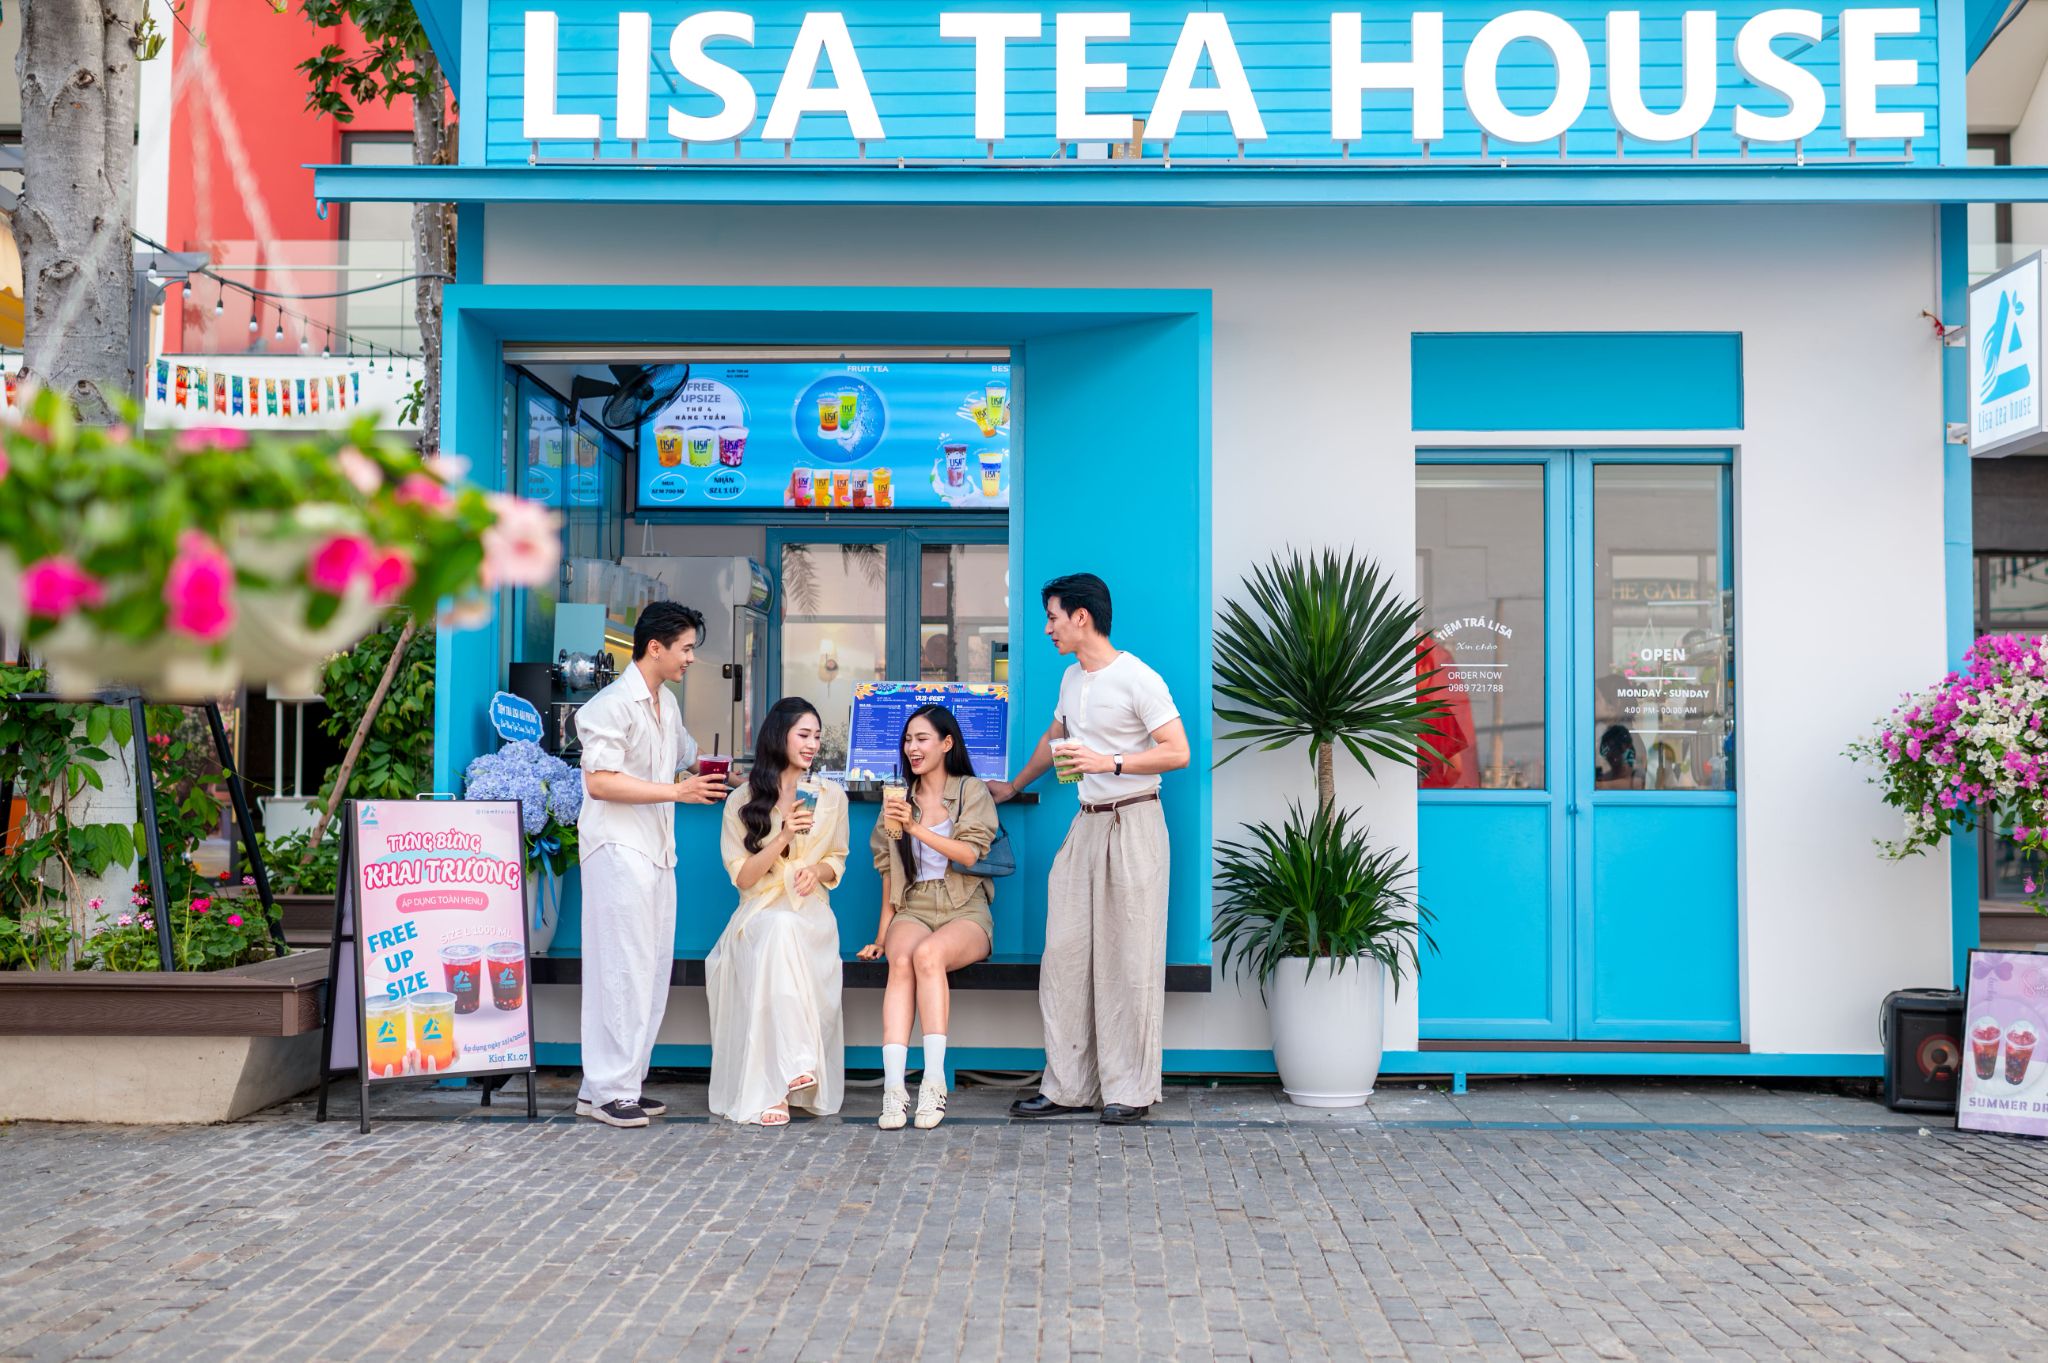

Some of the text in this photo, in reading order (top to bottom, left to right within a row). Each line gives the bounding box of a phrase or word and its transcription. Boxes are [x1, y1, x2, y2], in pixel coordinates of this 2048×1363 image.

[524, 8, 1926, 144] LISA TEA HOUSE
[991, 365, 1009, 373] BES
[687, 382, 714, 392] FREE
[681, 394, 721, 403] UPSIZE
[660, 439, 675, 450] LISA
[694, 439, 708, 450] LISA
[724, 439, 739, 450] LISA
[1436, 620, 1462, 640] TIỆM
[1487, 620, 1513, 640] LISA
[1641, 648, 1686, 661] OPEN
[1448, 672, 1502, 680] ORDER NOW
[1617, 688, 1662, 698] MONDAY
[1669, 689, 1710, 698] SUNDAY
[1643, 706, 1656, 714] PM
[1684, 706, 1697, 714] AM
[436, 828, 481, 854] BỪNG
[364, 856, 520, 890] KHAI TRƯƠNG
[402, 894, 483, 908] ÁP DỤNG TOÀN MENU
[367, 920, 418, 954] FREE
[440, 927, 463, 945] SIZE
[384, 950, 414, 973] UP
[386, 970, 429, 1002] SIZE
[464, 1044, 472, 1053] Áp
[488, 1053, 506, 1062] Kiot
[1969, 1096, 2028, 1112] SUMMER
